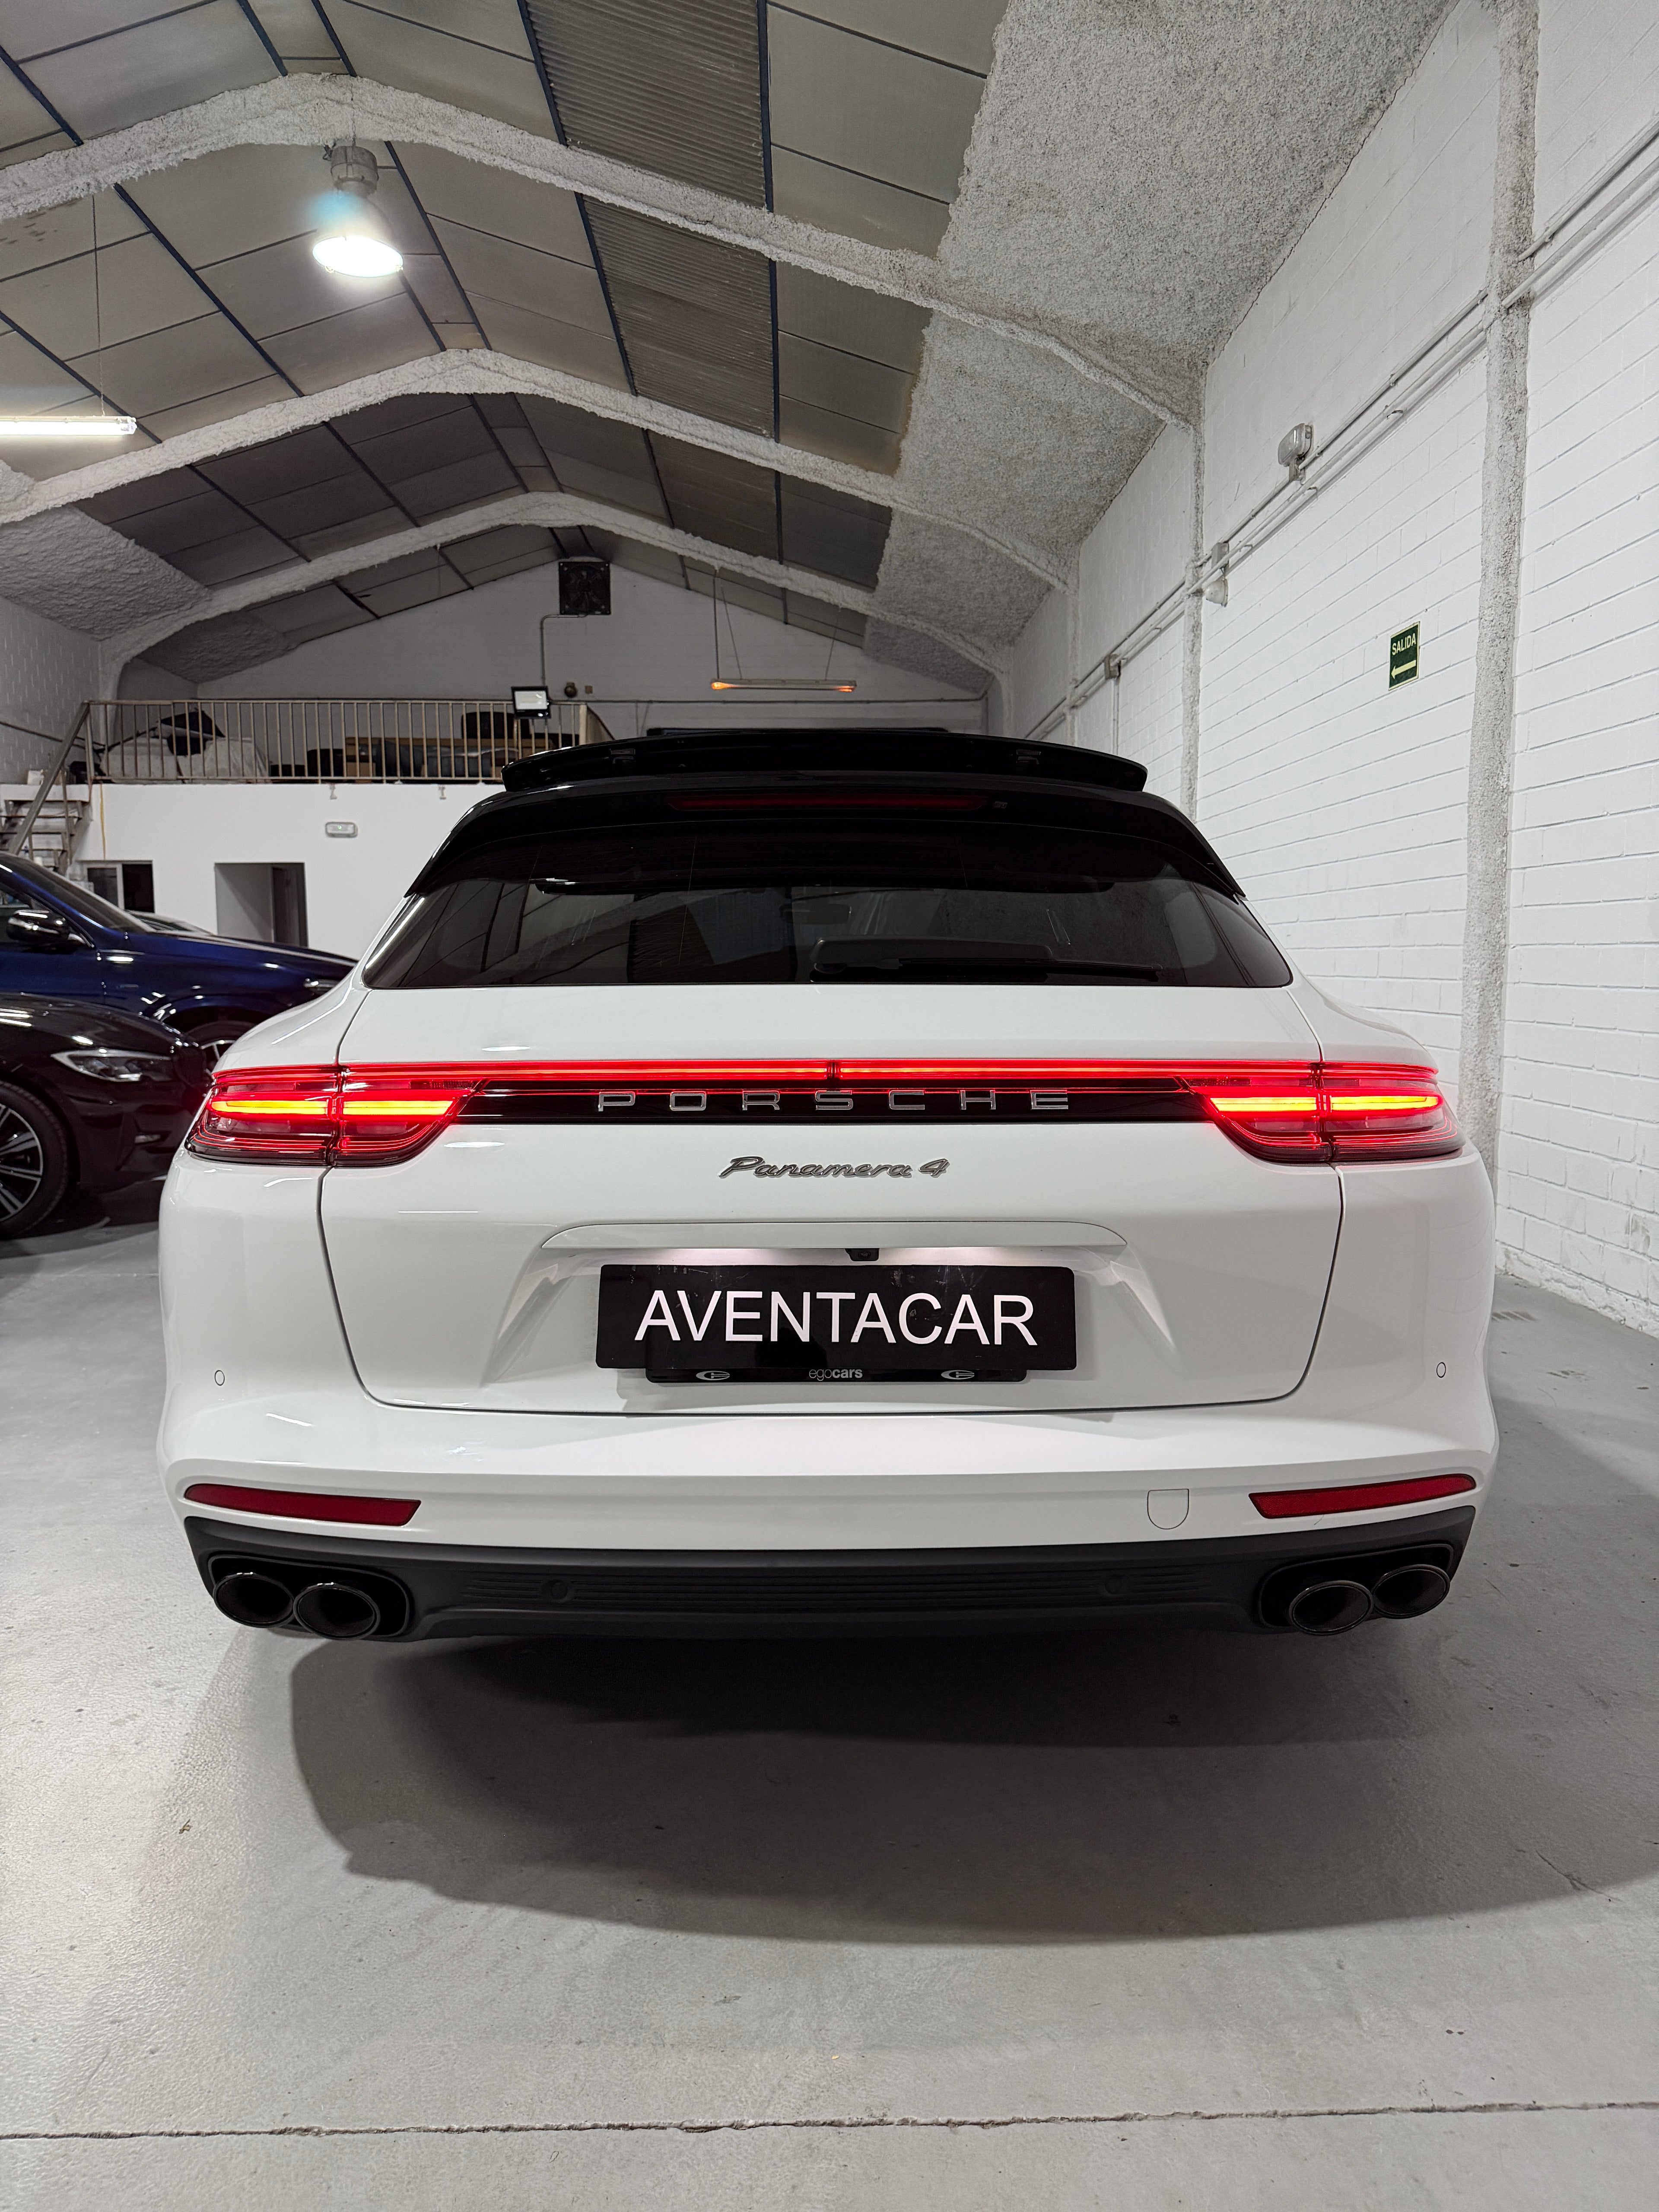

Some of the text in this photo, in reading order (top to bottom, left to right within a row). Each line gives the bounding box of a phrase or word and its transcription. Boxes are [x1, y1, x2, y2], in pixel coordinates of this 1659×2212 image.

[1392, 633, 1416, 655] SALIDA
[598, 1090, 1069, 1112] PORSCHE
[718, 1156, 950, 1178] Panamera 4
[634, 1290, 1037, 1346] AVENTACAR
[809, 1369, 863, 1381] egocars
